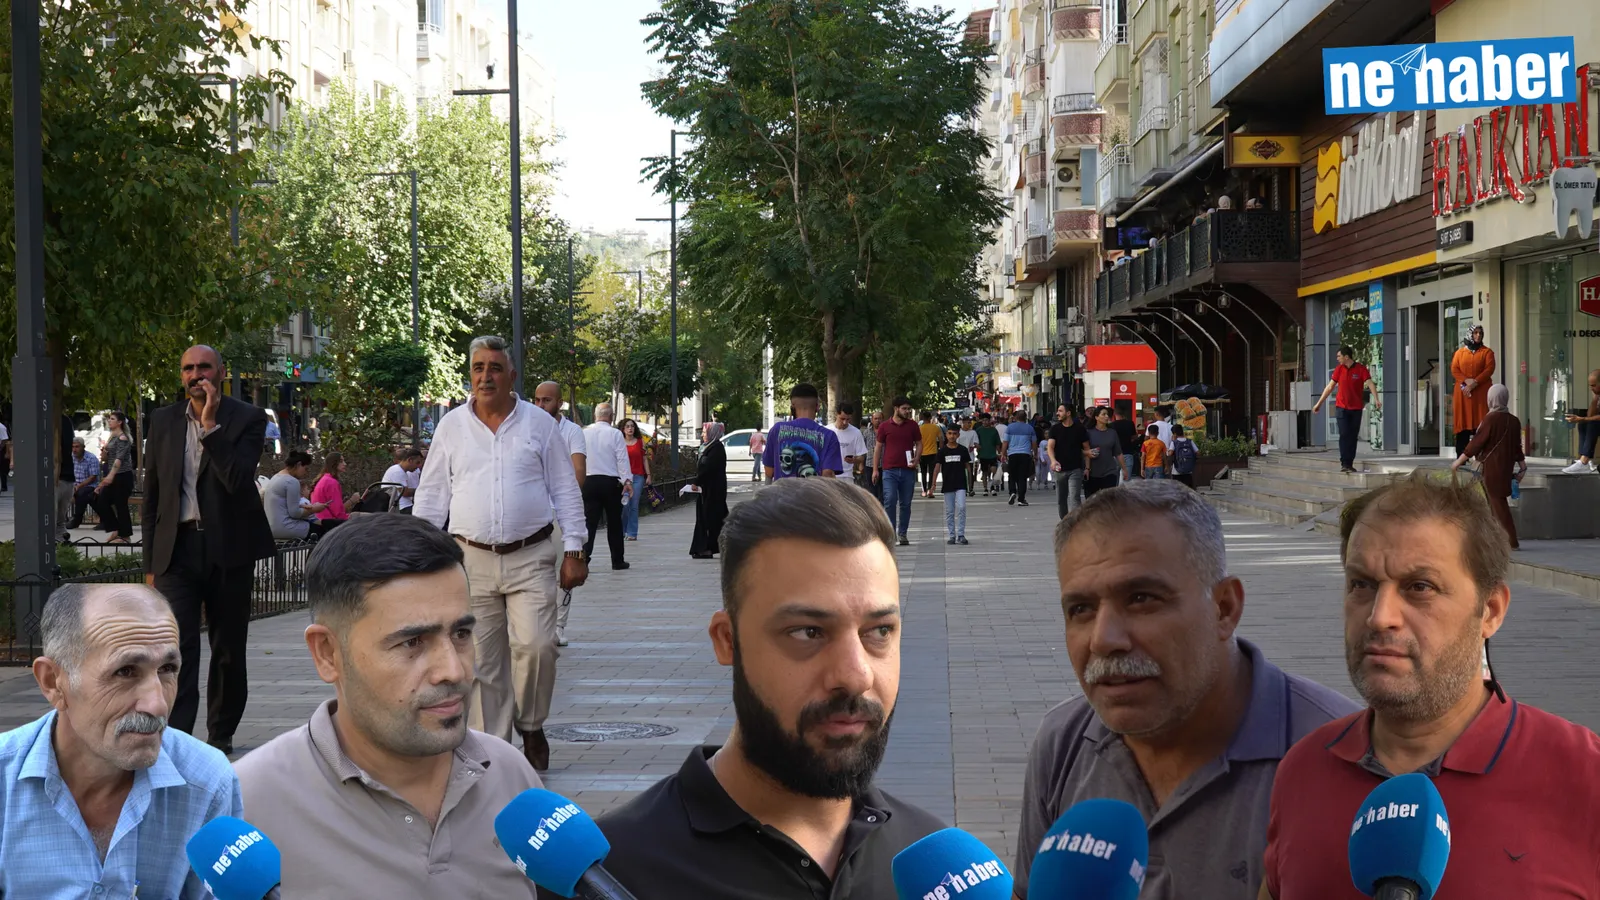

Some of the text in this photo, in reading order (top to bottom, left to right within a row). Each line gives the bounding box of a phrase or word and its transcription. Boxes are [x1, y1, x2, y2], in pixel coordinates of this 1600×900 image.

[1337, 110, 1424, 225] istikbal
[528, 803, 581, 851] ne haber
[1366, 802, 1419, 825] haber
[212, 830, 264, 876] ne haber
[1056, 831, 1117, 860] haber
[951, 860, 1004, 894] haber
